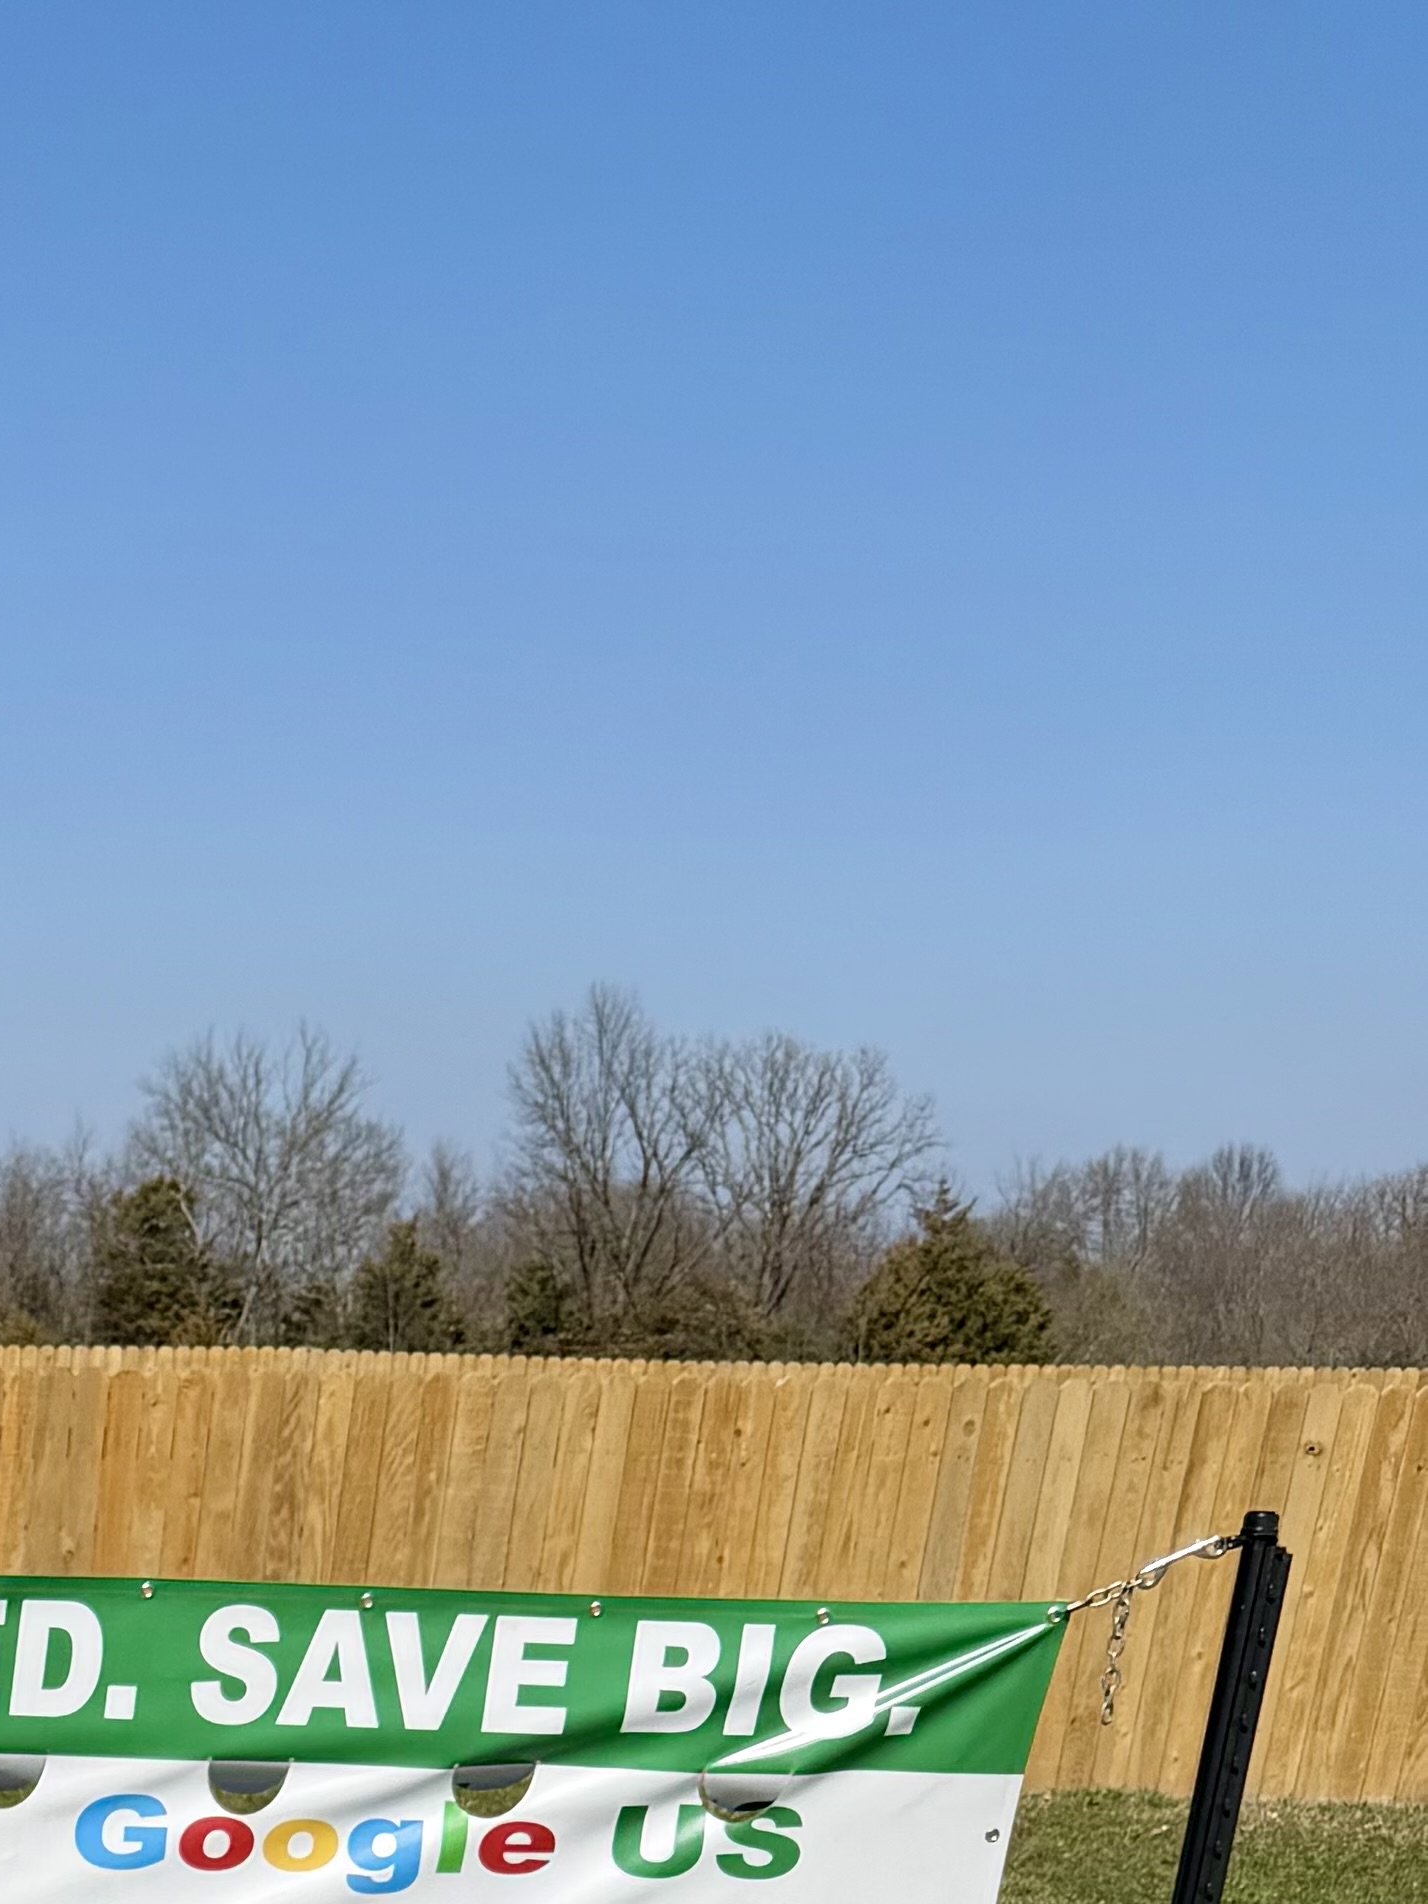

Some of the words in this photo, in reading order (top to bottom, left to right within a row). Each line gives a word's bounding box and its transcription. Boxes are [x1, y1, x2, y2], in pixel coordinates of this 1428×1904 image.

[190, 1604, 578, 1735] SAVE
[620, 1620, 924, 1737] BIG.
[74, 1793, 555, 1895] Google
[611, 1803, 804, 1880] US
